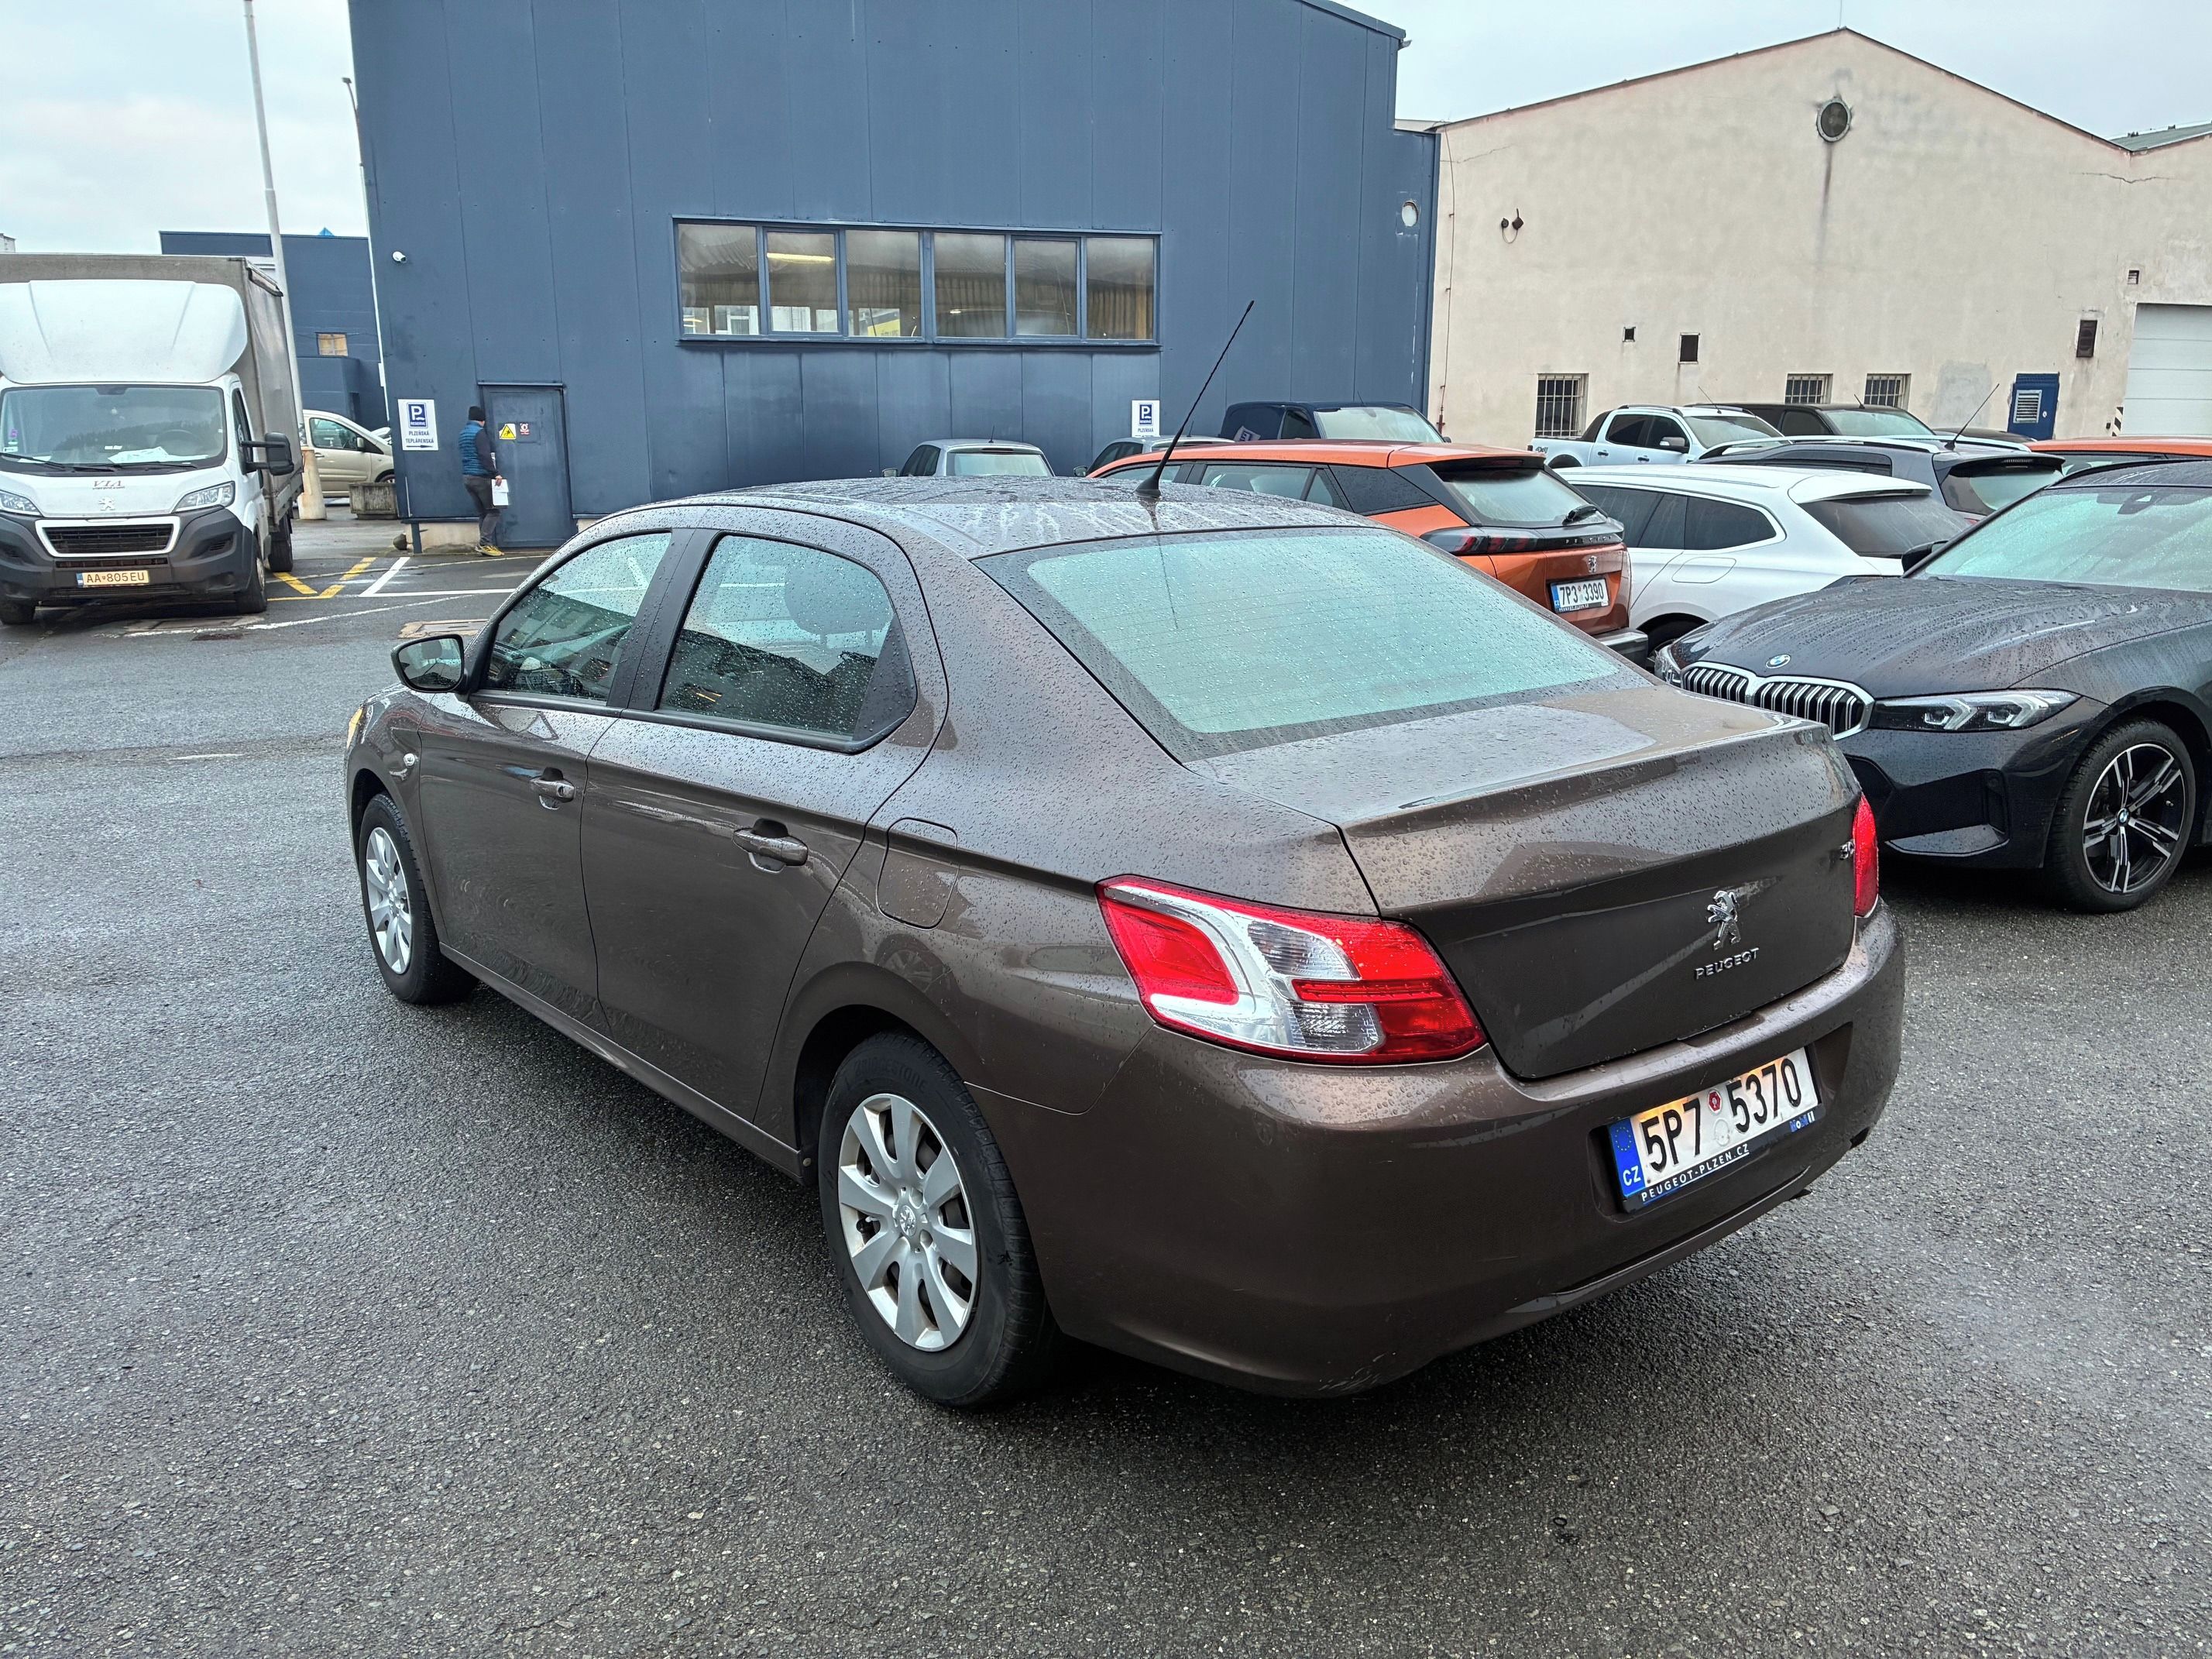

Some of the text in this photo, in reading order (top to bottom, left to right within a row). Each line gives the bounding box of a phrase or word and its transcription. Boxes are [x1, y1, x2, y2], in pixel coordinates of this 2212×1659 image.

[410, 406, 422, 421] P
[1142, 406, 1150, 419] P
[87, 572, 145, 583] AA 805EU
[1559, 582, 1605, 606] 7P3 3390
[1695, 946, 1760, 980] PEUGEOT
[1640, 1058, 1802, 1173] 5P7 5370
[1623, 1165, 1641, 1187] CZ
[1641, 1143, 1750, 1202] PEUGEOT-PLZEN.CZ
